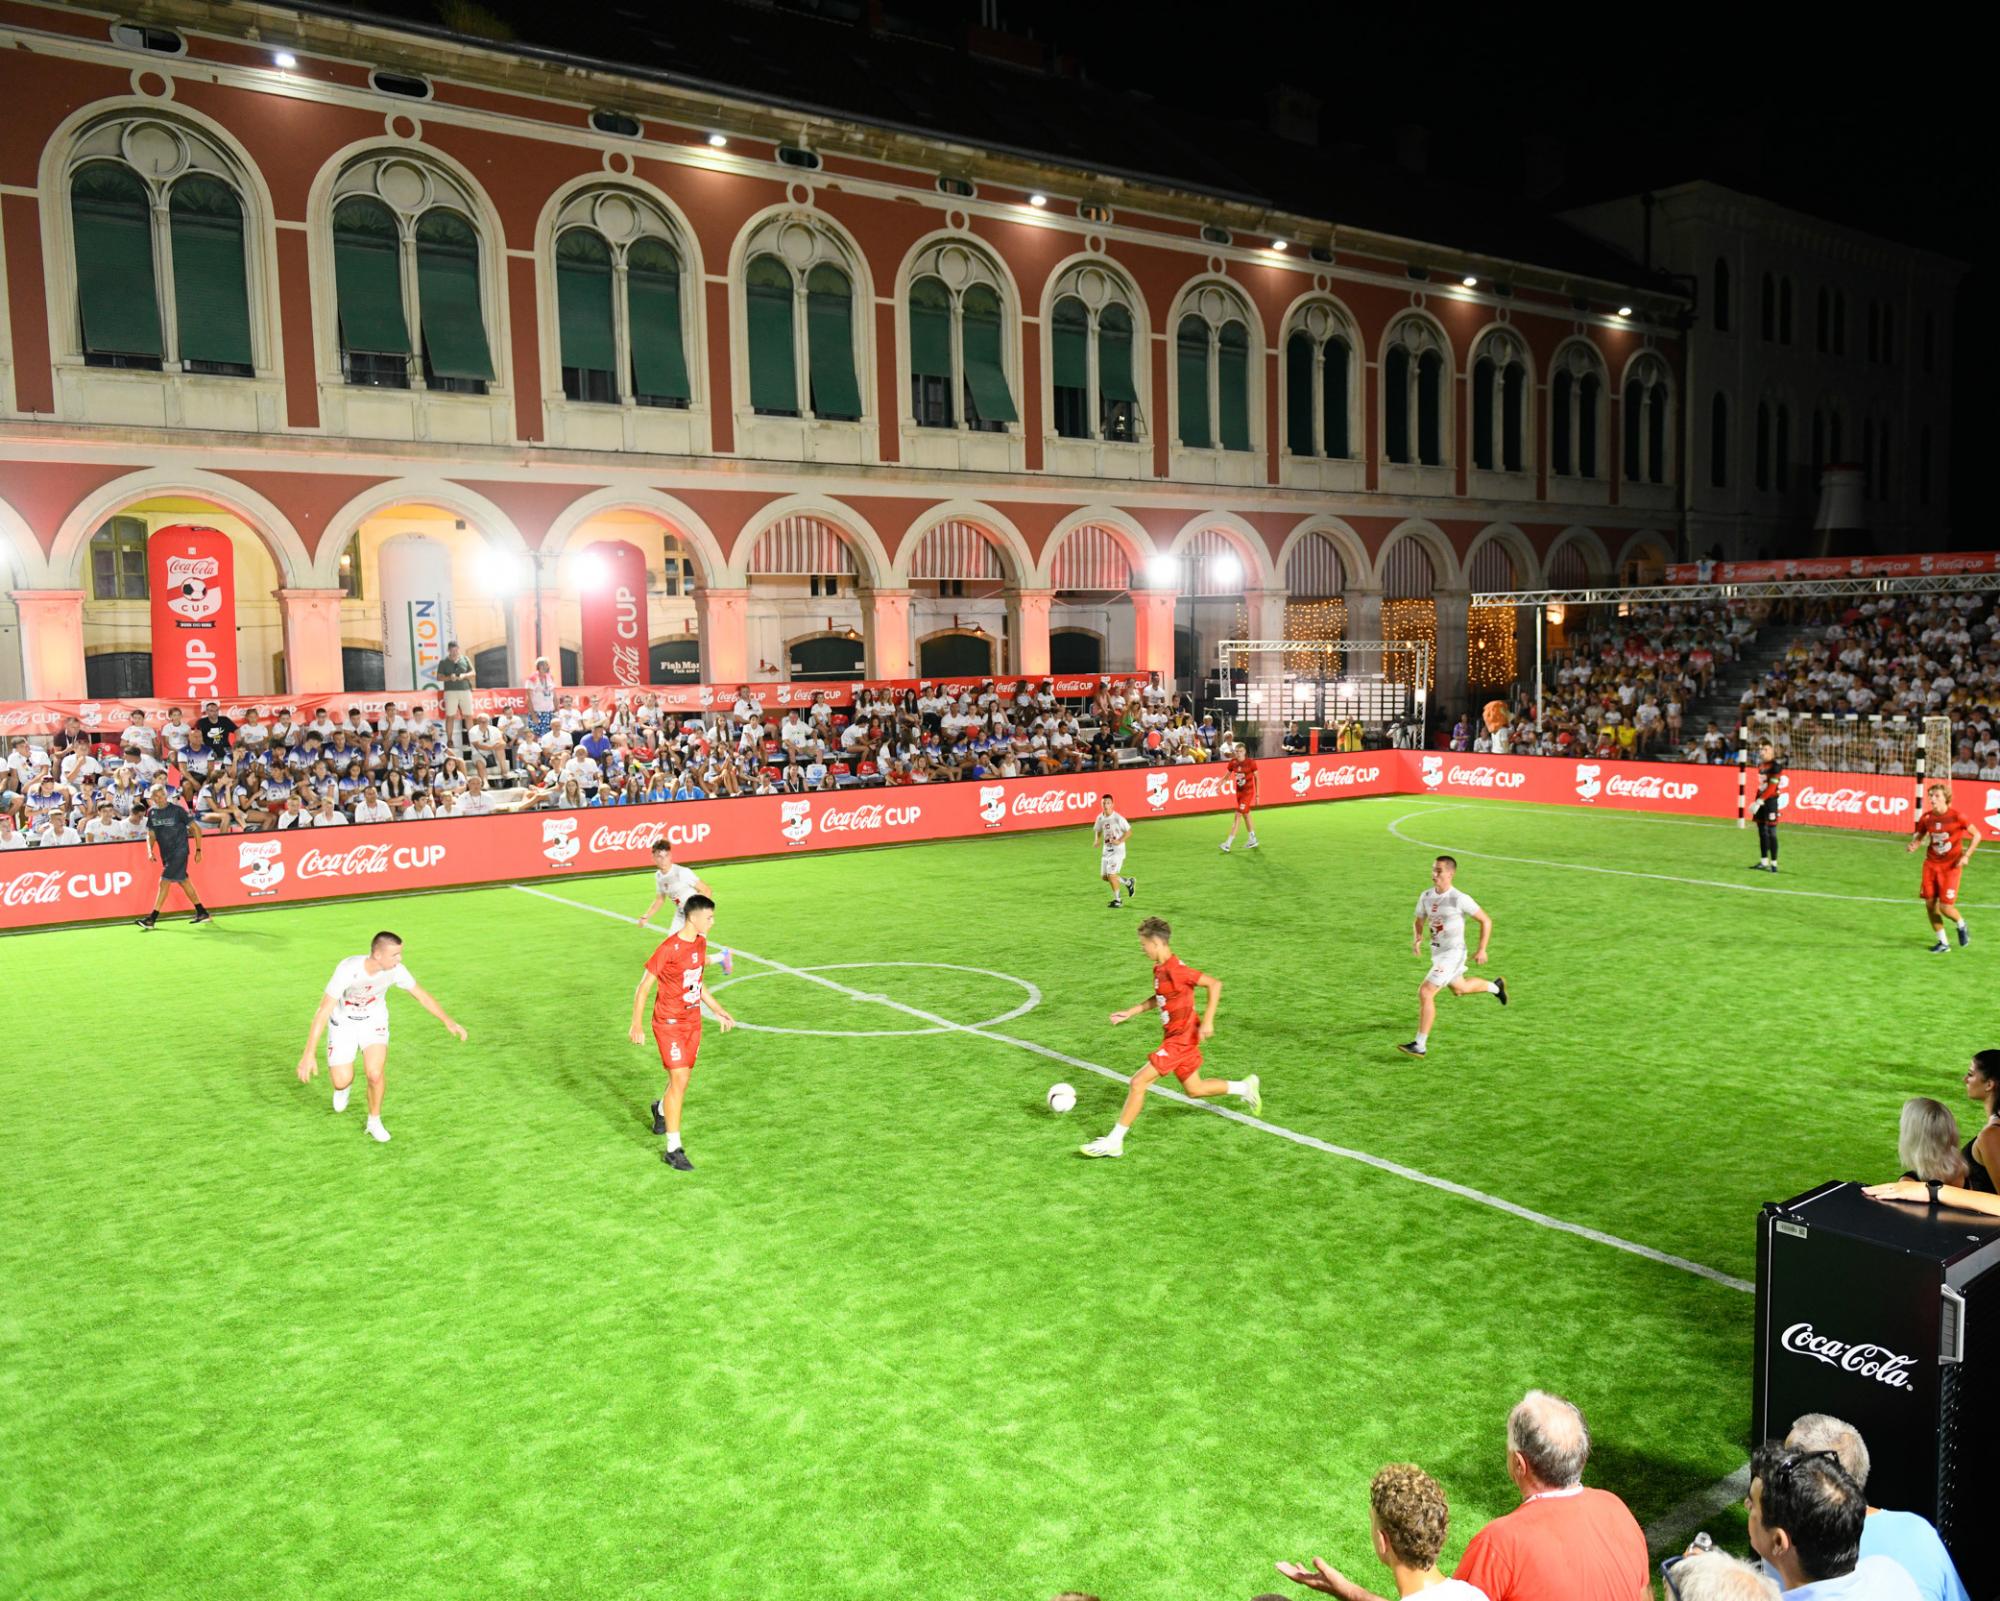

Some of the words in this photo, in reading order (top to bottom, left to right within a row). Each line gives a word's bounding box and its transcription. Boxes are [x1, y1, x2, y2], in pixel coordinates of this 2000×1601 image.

[169, 559, 215, 575] Coca-Cola
[181, 604, 209, 612] CUP
[616, 586, 638, 639] CUP
[660, 661, 682, 670] Fish
[824, 690, 841, 700] CUP
[1080, 682, 1093, 690] CUP
[494, 697, 525, 708] IGRE
[667, 695, 688, 704] CUP
[32, 712, 61, 724] CUP
[1315, 765, 1357, 787] Coca-Cola
[1356, 767, 1379, 783] CUP
[1447, 765, 1496, 787] Coca-Cola
[1495, 771, 1526, 788] CUP
[1605, 774, 1664, 799] Coca-Cola
[1663, 782, 1698, 799] CUP
[1012, 790, 1067, 816] Coca-Cola
[1066, 791, 1097, 809] CUP
[1795, 786, 1867, 814] Coca-Cola
[1865, 795, 1909, 815] CUP
[820, 804, 885, 833] Coca-Cola
[885, 806, 921, 825] CUP
[667, 823, 711, 845] CUP
[296, 844, 393, 880] Coca-Cola
[393, 845, 446, 870] CUP
[67, 871, 132, 898] CUP
[1781, 1322, 1919, 1388] Coca-Cola
